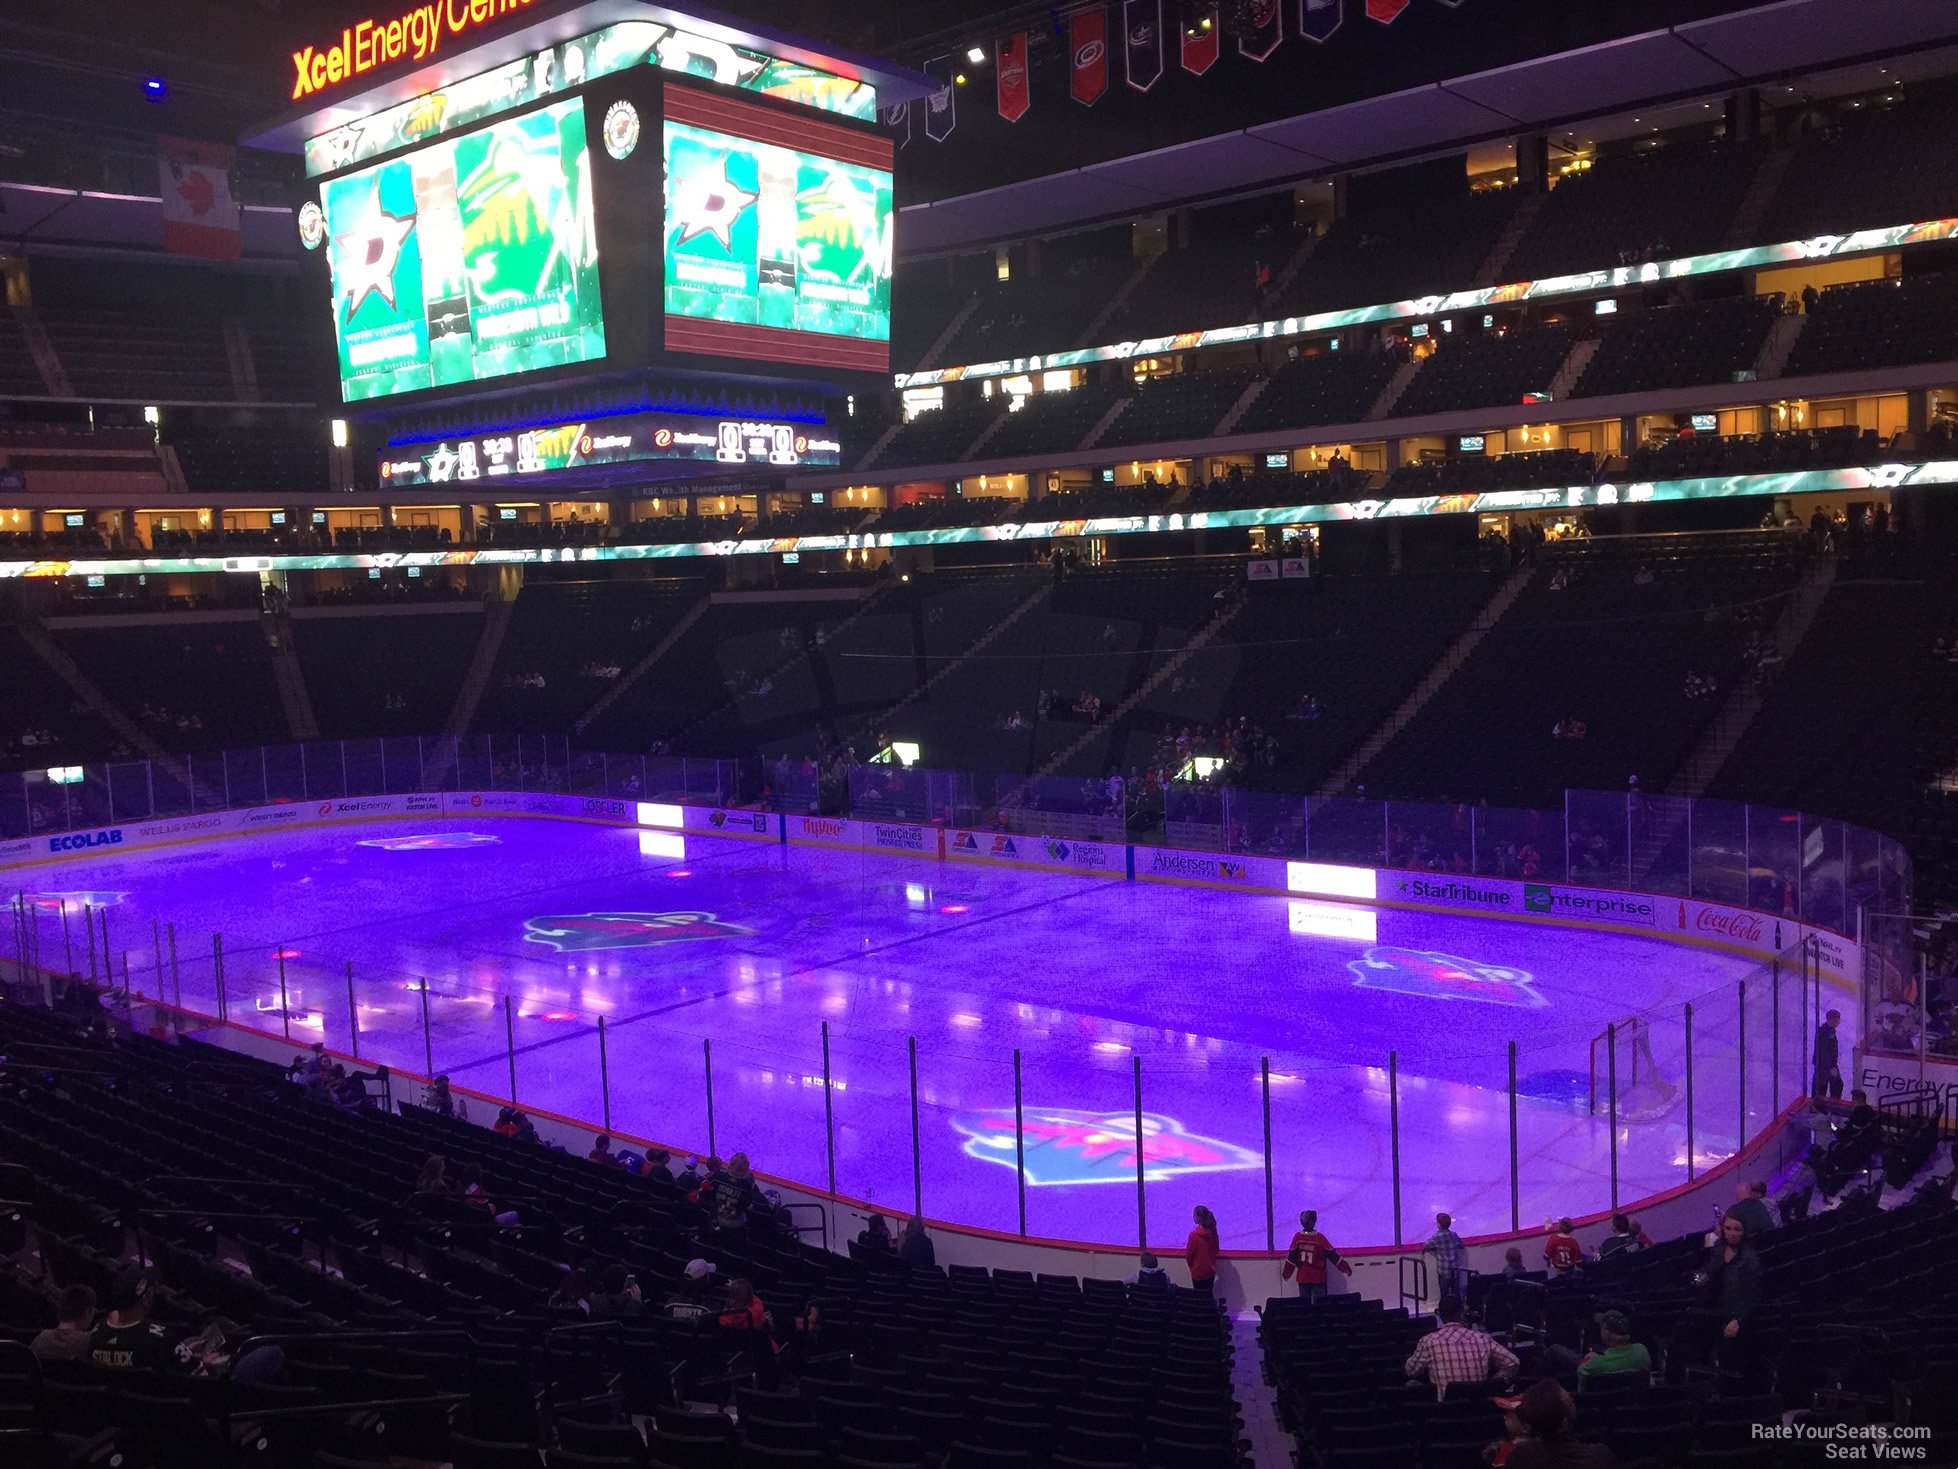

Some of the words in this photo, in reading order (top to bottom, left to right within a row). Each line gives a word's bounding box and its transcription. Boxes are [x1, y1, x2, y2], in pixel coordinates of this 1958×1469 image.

[293, 29, 351, 99] Xcel
[355, 0, 443, 72] Energy
[643, 487, 658, 496] RBC
[692, 483, 741, 494] Management
[337, 803, 360, 812] Xcel
[361, 801, 391, 812] Energy
[140, 824, 180, 837] WELLS
[183, 818, 221, 831] FARGO
[50, 830, 123, 851] ECOLAB
[1073, 843, 1104, 855] Regions
[1073, 854, 1107, 867] Hospital
[1153, 852, 1214, 871] Andersen
[1832, 956, 1845, 970] LIVE
[1863, 1069, 1945, 1097] Energy
